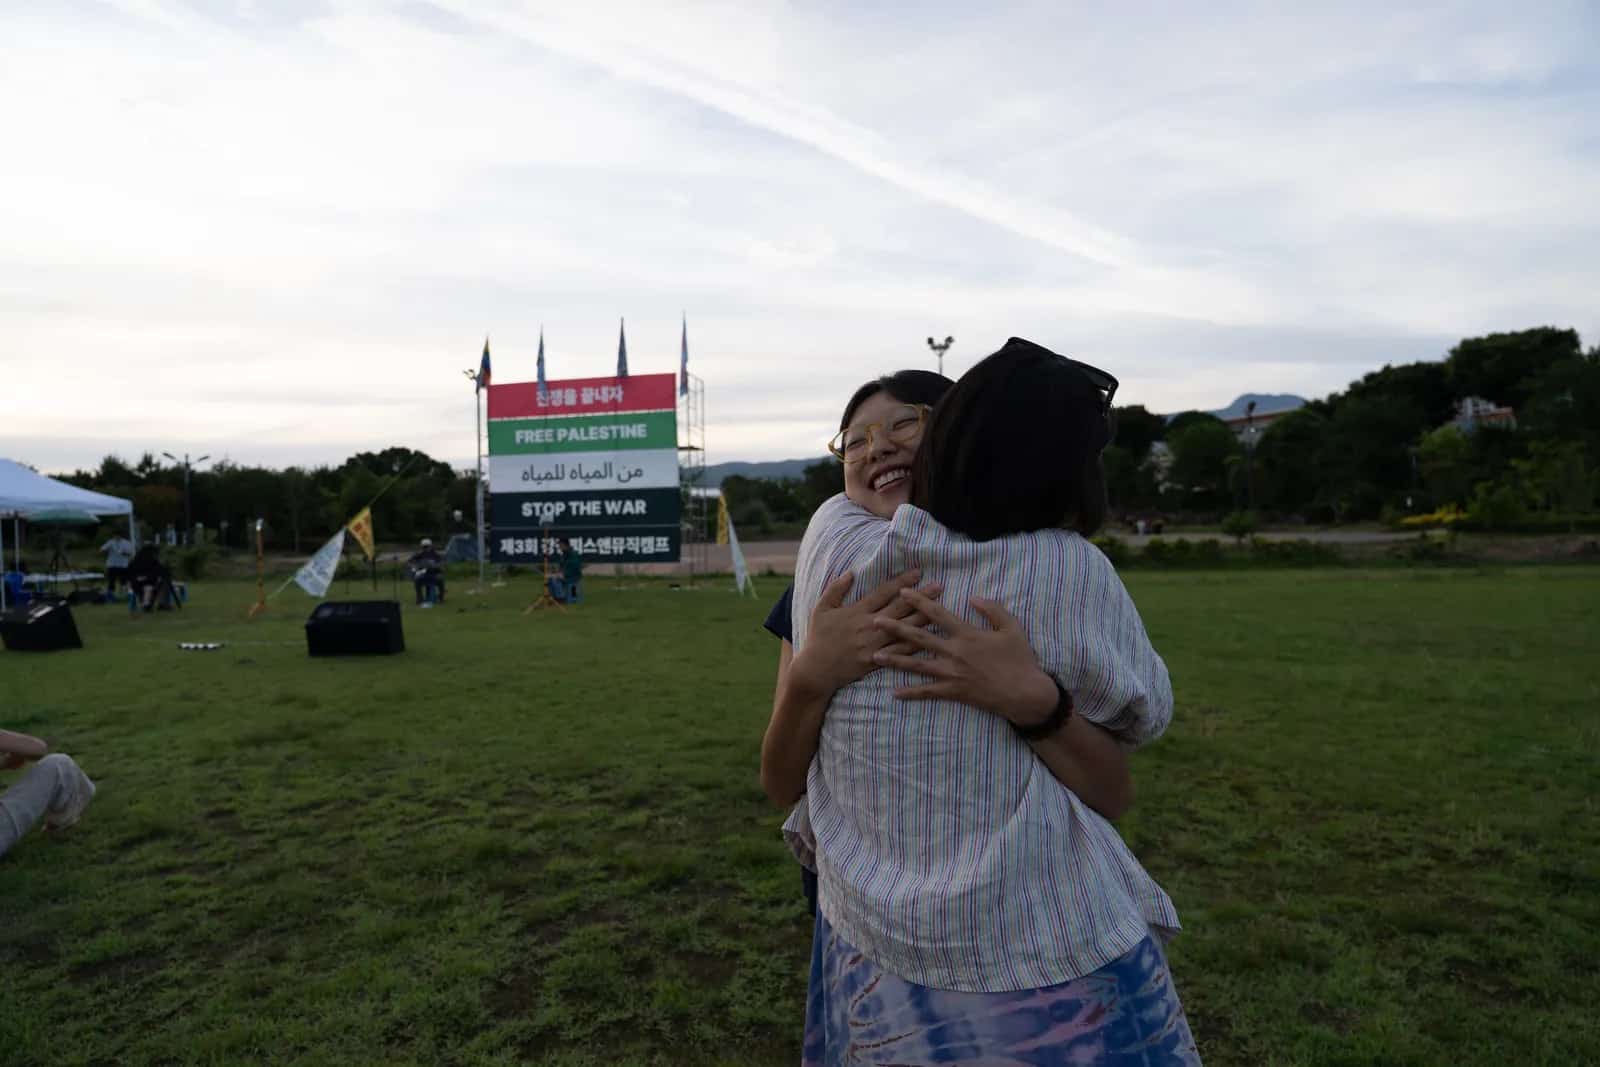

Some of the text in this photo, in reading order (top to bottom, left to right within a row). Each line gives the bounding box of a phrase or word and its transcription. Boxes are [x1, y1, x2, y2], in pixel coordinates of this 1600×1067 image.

[581, 384, 624, 405] 끝내자
[515, 424, 647, 444] FREE PALESTINE
[521, 461, 643, 485] من المياه للمياه
[521, 499, 646, 517] STOP THE WAR
[500, 537, 538, 555] 제3회
